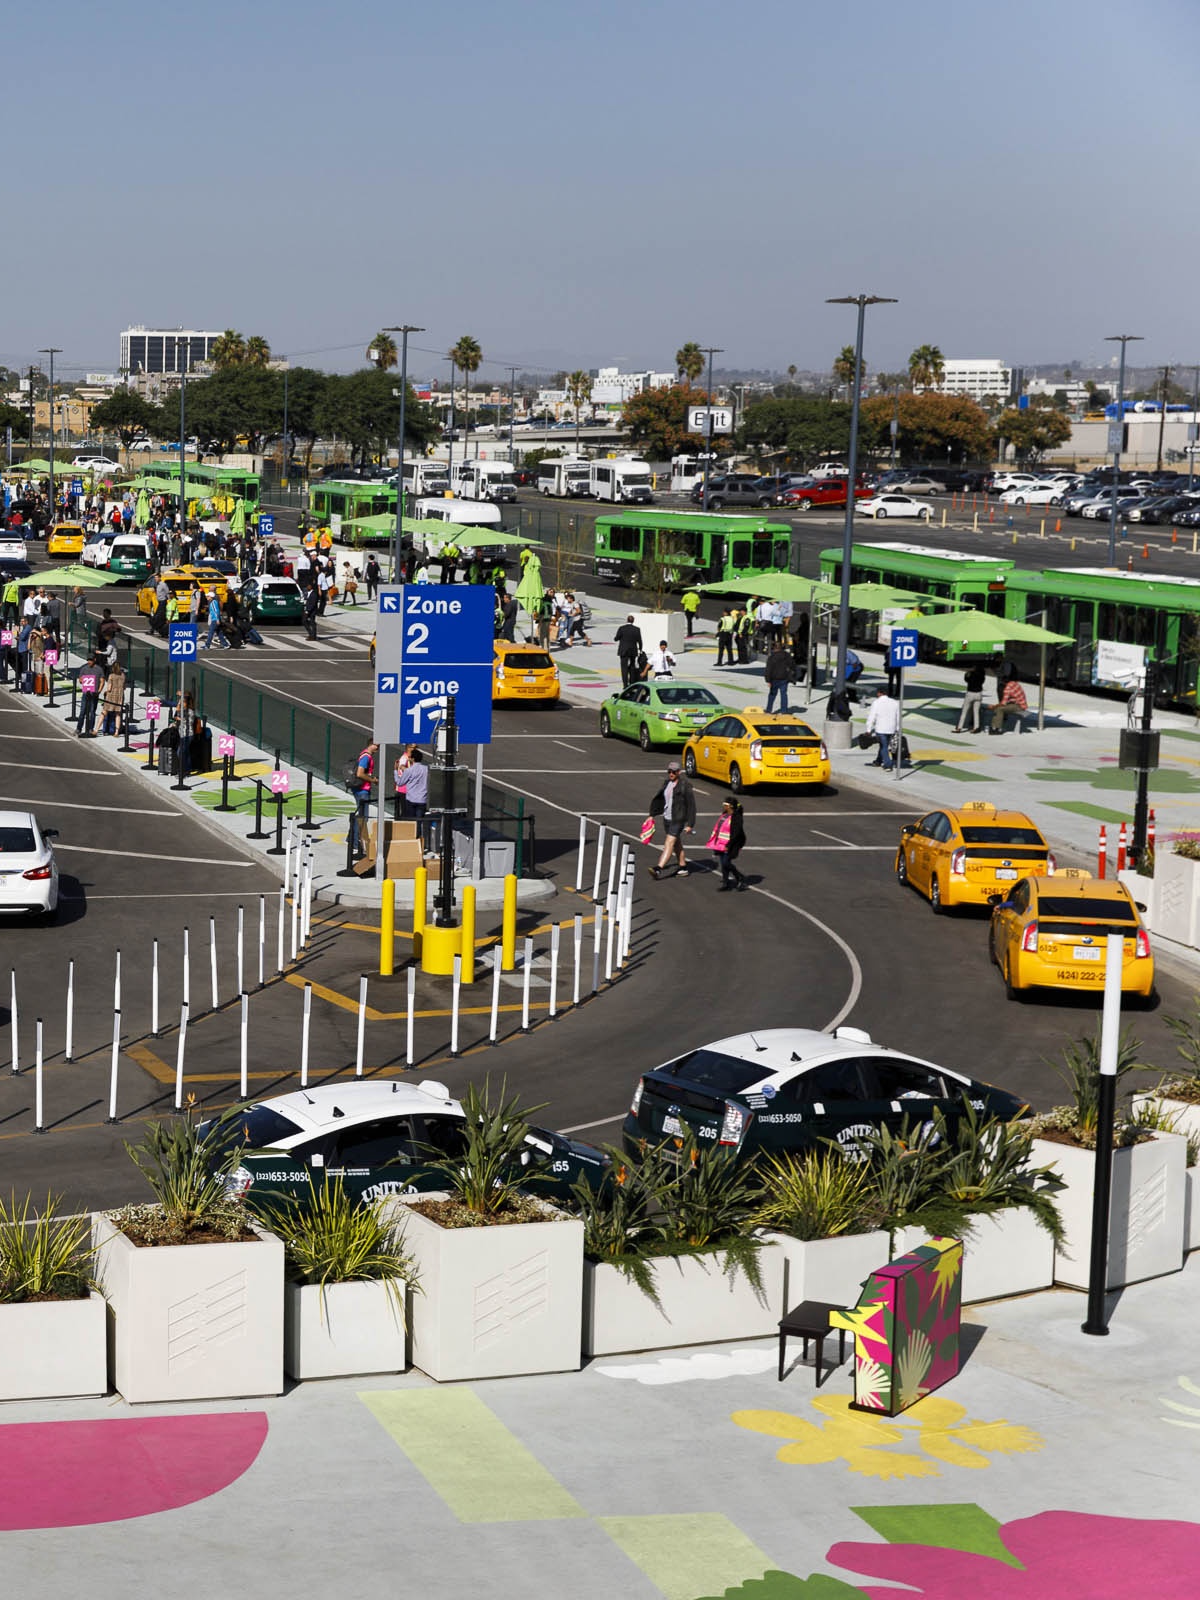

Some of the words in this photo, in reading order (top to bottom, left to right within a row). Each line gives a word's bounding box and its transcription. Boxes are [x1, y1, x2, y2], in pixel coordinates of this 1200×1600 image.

[695, 412, 727, 426] Eit
[260, 523, 273, 532] 1C
[406, 596, 462, 614] Zone
[406, 622, 430, 654] 2
[171, 641, 195, 655] 2D
[894, 645, 916, 660] 1D
[46, 652, 57, 660] 21
[82, 677, 95, 687] 22
[404, 676, 460, 695] Zone
[147, 704, 159, 714] 23
[406, 703, 422, 734] 1
[219, 738, 235, 748] 24
[272, 774, 288, 785] 24
[981, 887, 999, 896] (424)
[1057, 970, 1079, 980] (424)
[699, 1126, 718, 1139] 205
[256, 1171, 310, 1182] (323)653-5050
